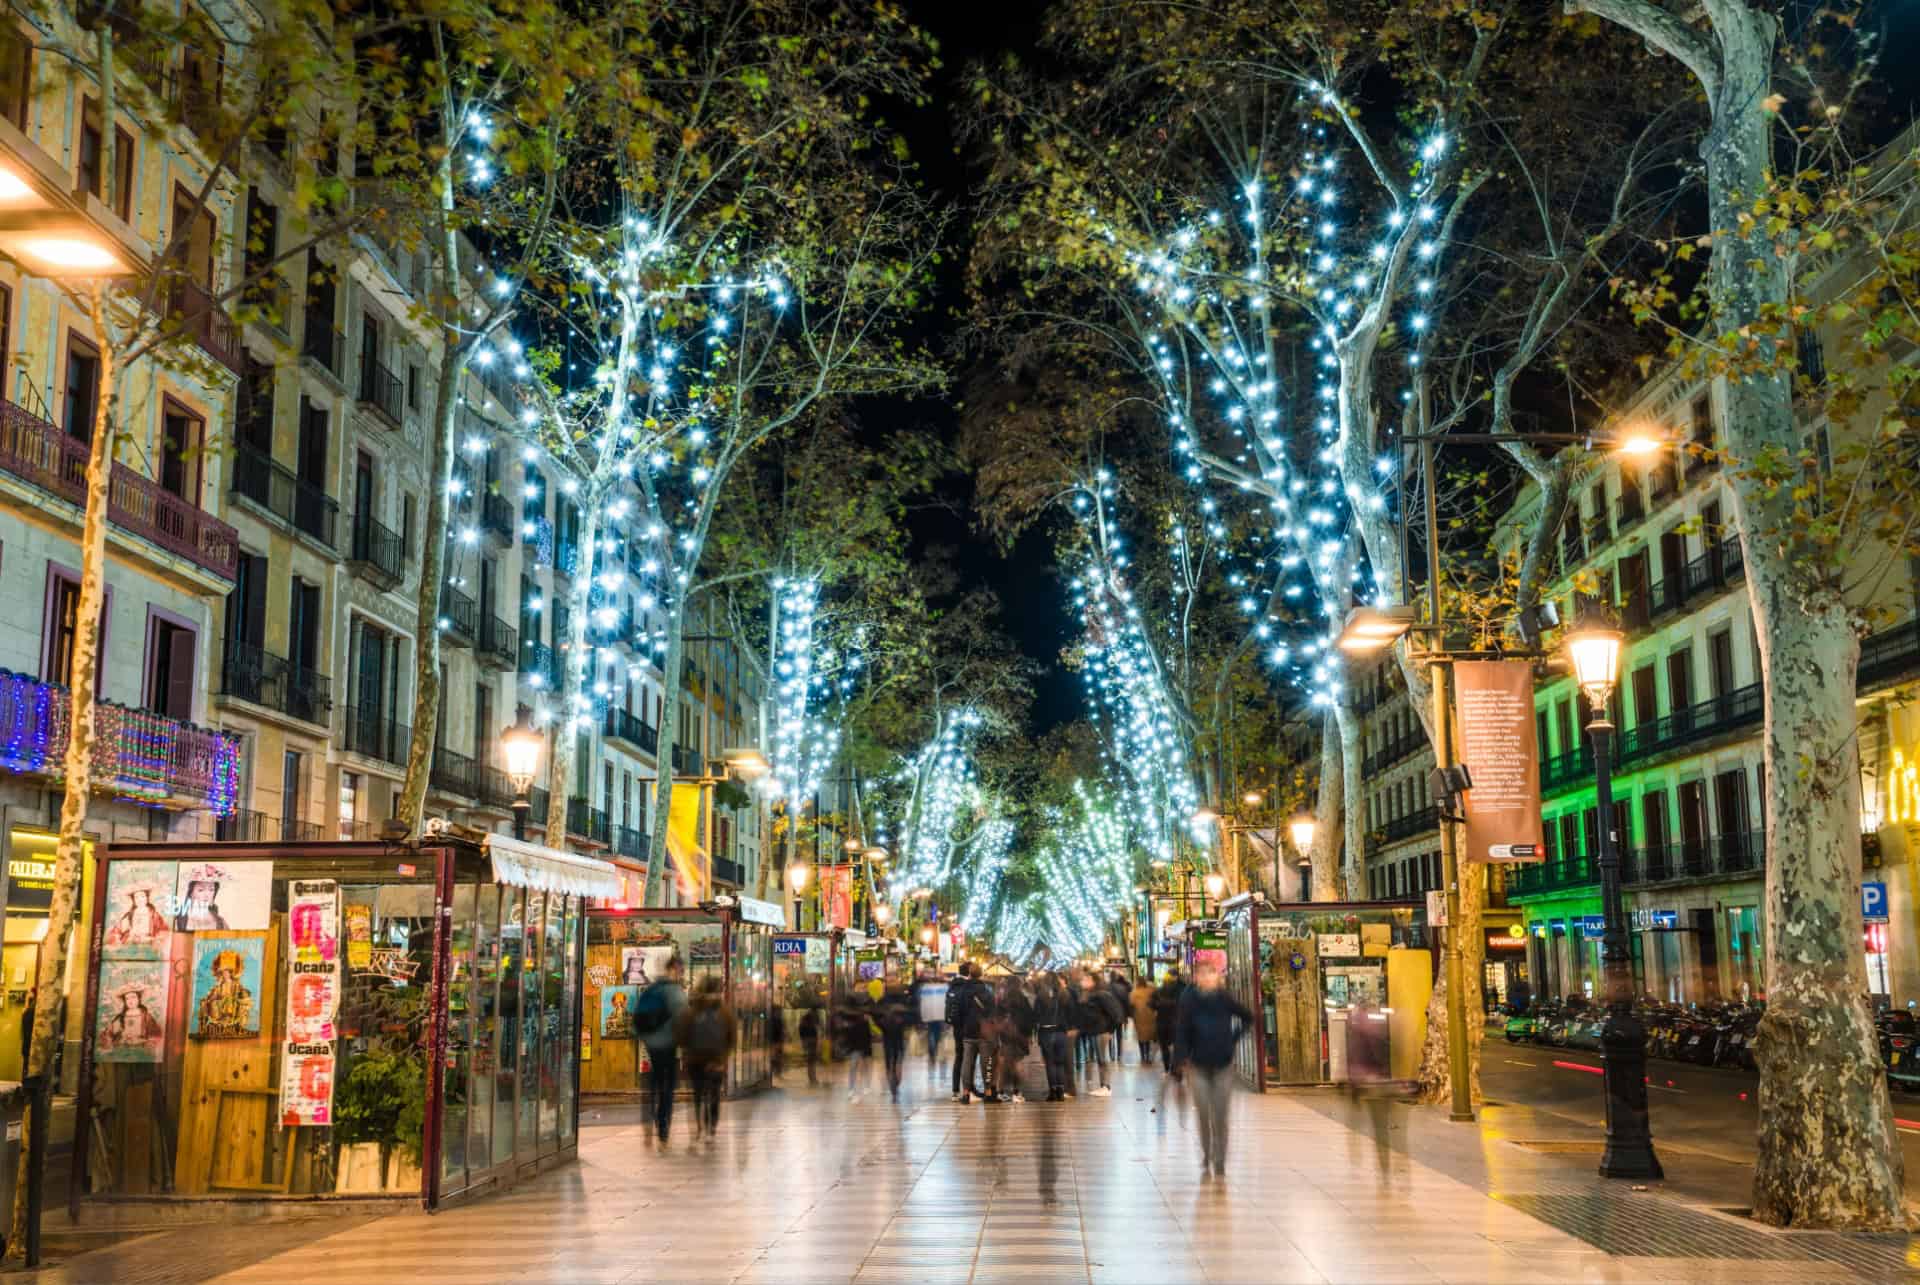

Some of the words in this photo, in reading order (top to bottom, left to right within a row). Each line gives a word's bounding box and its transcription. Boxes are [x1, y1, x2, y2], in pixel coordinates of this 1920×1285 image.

[1862, 887, 1880, 913] P
[294, 960, 335, 974] Ocaña
[288, 1041, 329, 1055] Ocaña
